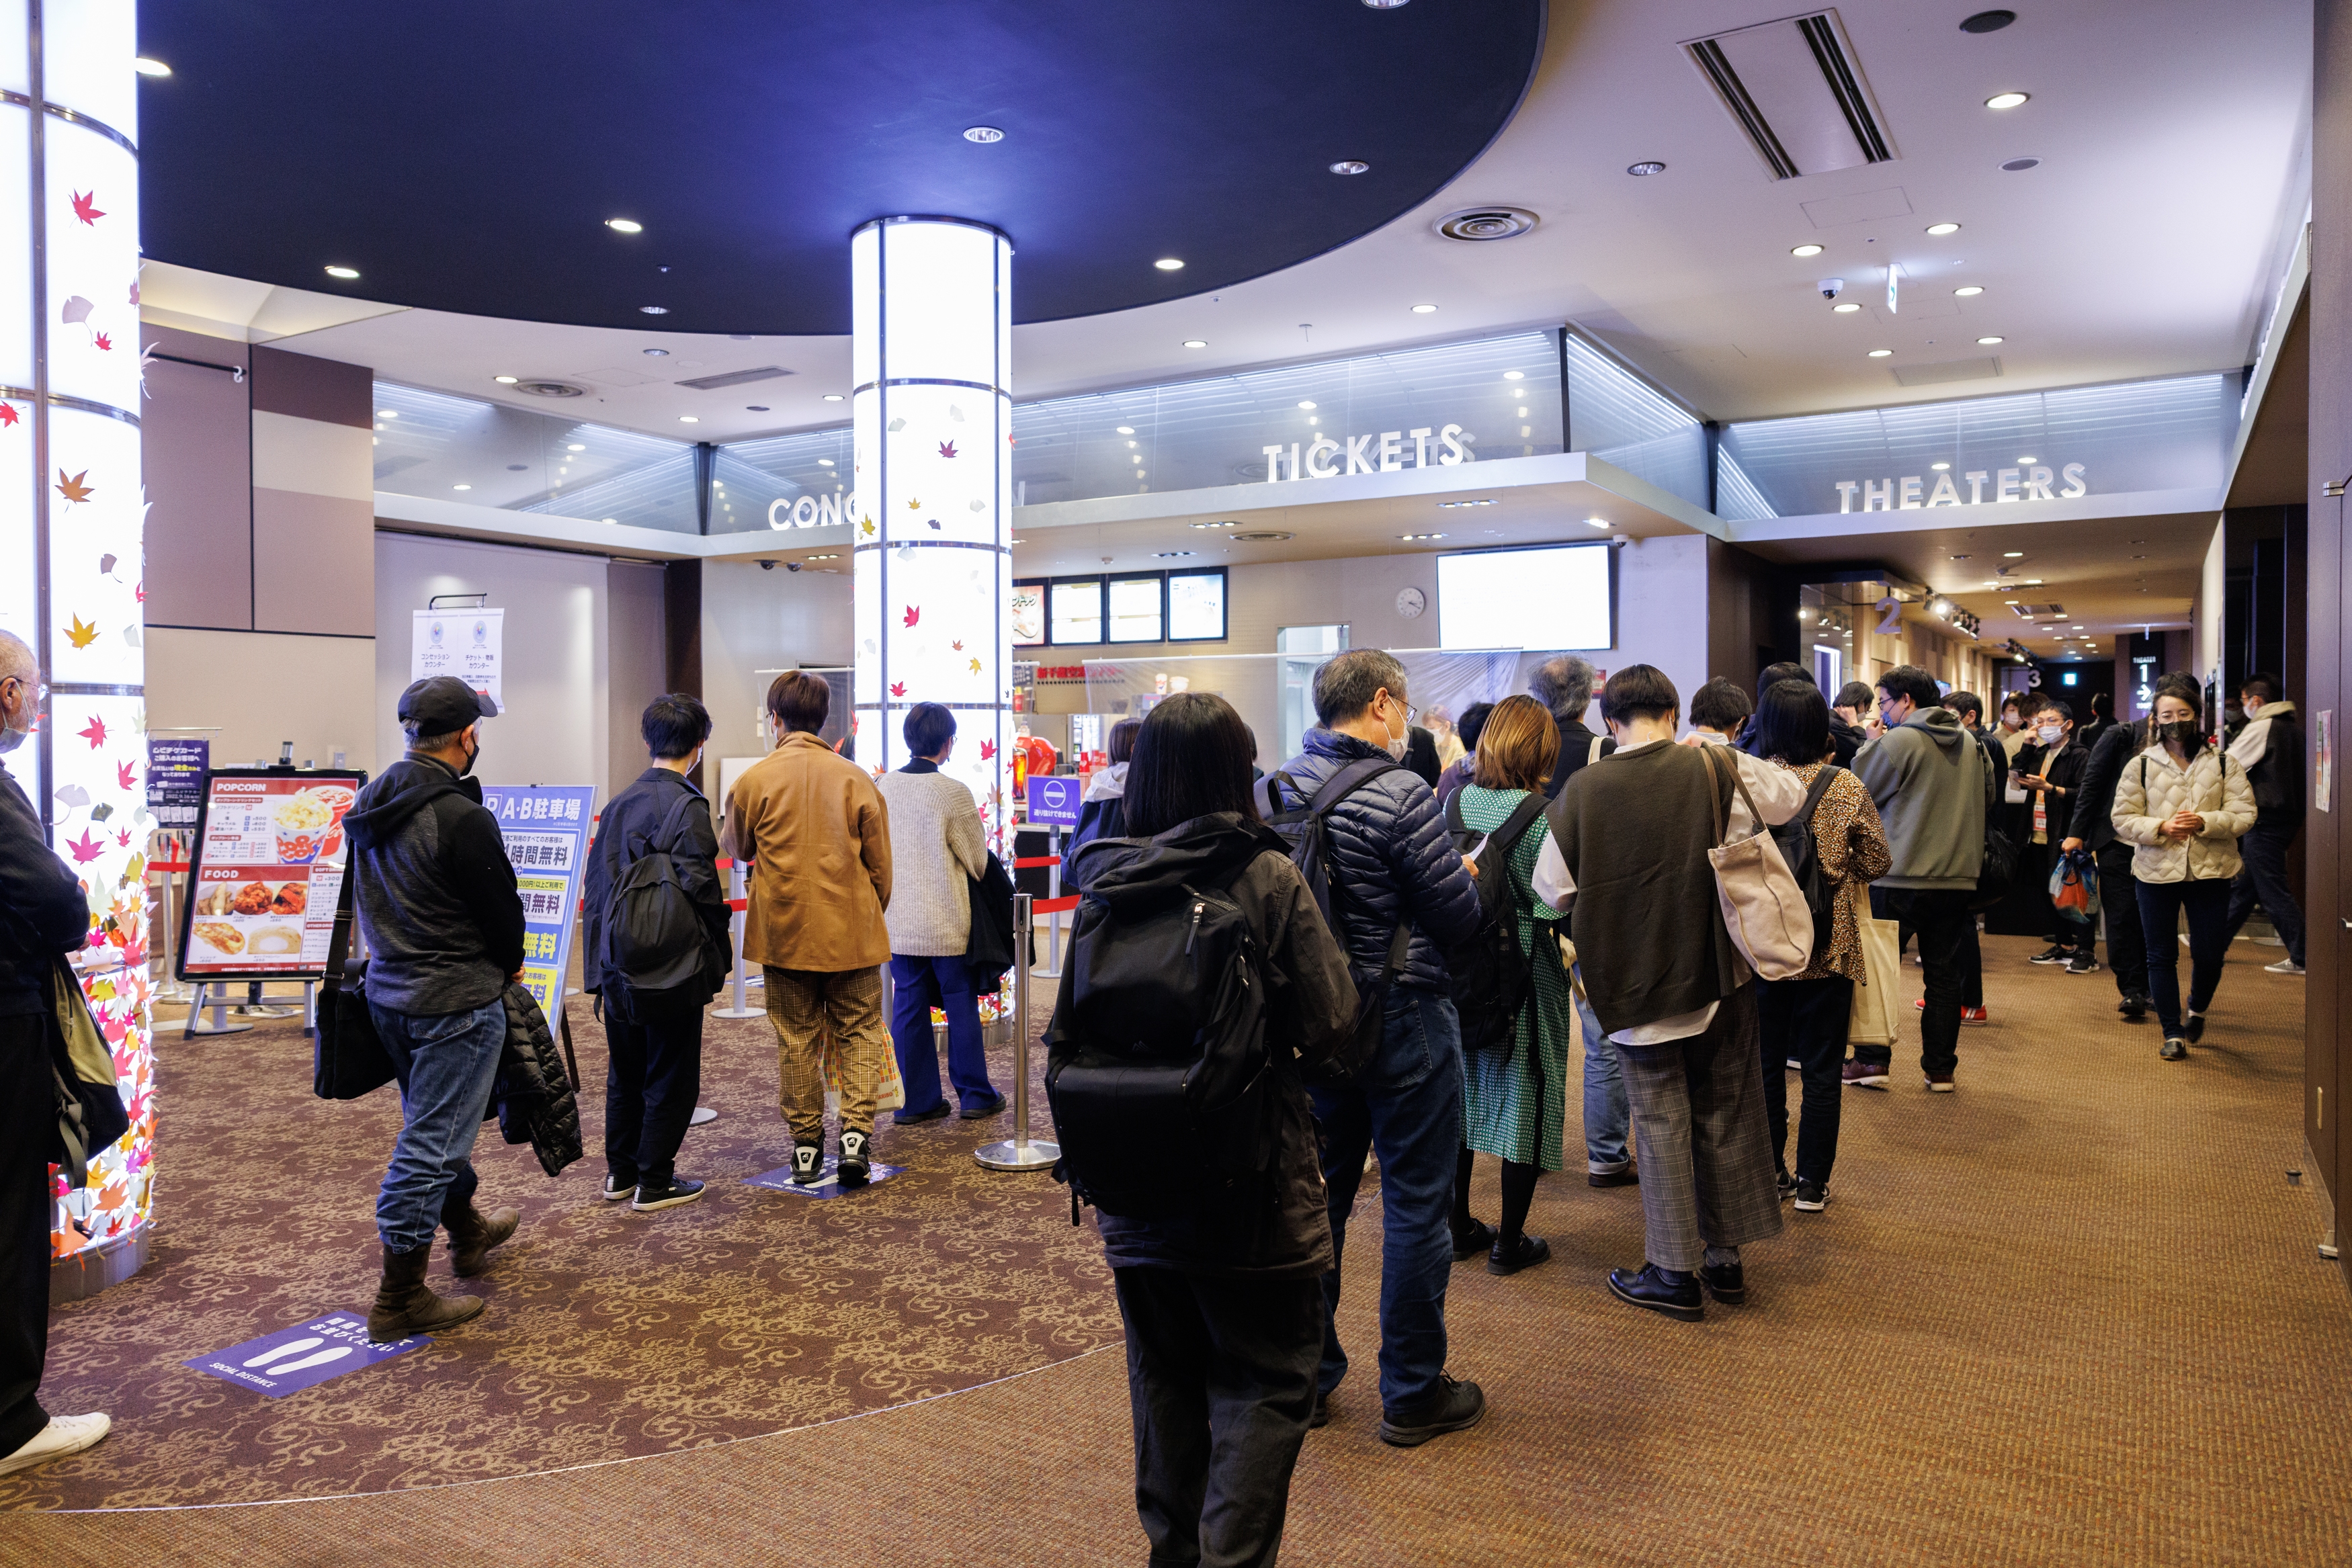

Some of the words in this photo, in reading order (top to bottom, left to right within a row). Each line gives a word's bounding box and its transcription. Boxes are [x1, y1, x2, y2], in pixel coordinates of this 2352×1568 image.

[1263, 423, 1464, 484] TICKETS
[1836, 462, 2086, 515] THEATERS
[1874, 597, 1902, 634] 2
[2028, 670, 2042, 688] 3
[2140, 664, 2148, 683] 1
[216, 783, 267, 792] POPCORN
[1034, 809, 1077, 819] 通り抜けできません
[204, 870, 239, 879] FOOD
[523, 931, 556, 959] 無料
[784, 1186, 821, 1195] DISTANCE
[325, 1317, 414, 1347] 間隔をて
[209, 1362, 239, 1375] SOCIAL
[235, 1371, 278, 1388] DISTANCE
